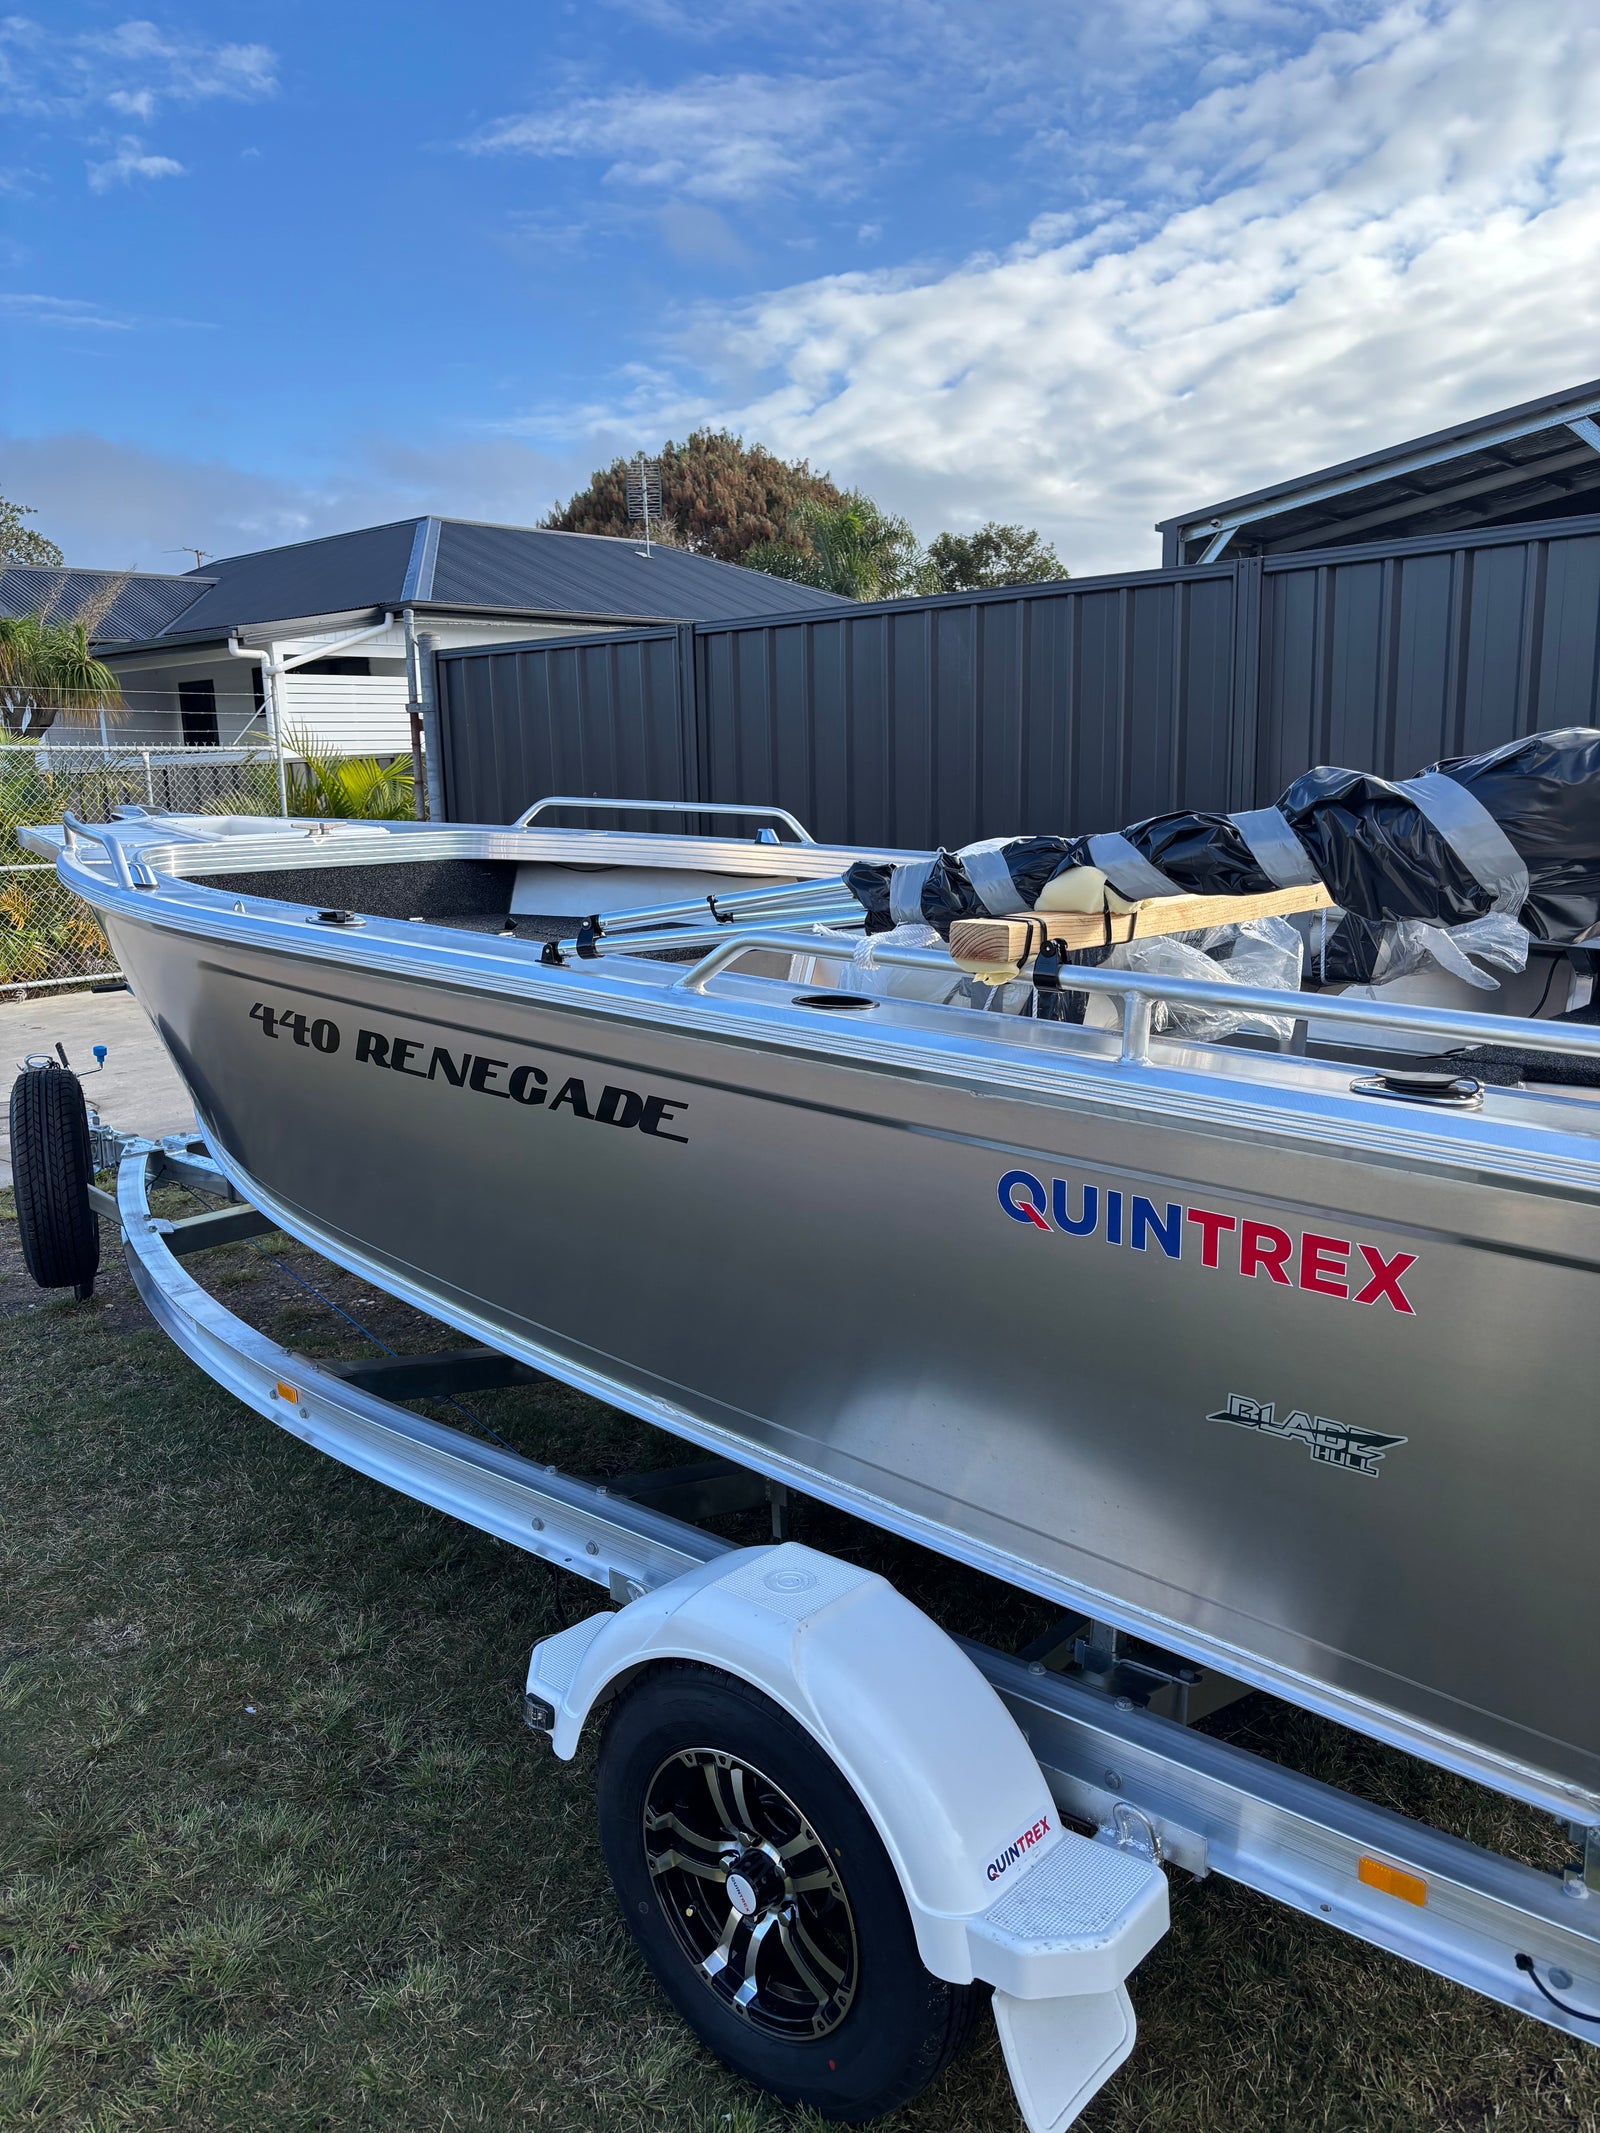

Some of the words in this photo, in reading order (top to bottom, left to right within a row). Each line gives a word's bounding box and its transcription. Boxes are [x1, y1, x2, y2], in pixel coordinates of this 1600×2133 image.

[249, 1002, 341, 1054] 440
[355, 1028, 689, 1145] RENEGADE
[997, 1169, 1419, 1316] QUINTREX
[1218, 1393, 1406, 1460] BLADE
[1311, 1444, 1380, 1478] HULL
[986, 1815, 1051, 1882] QUINTREX
